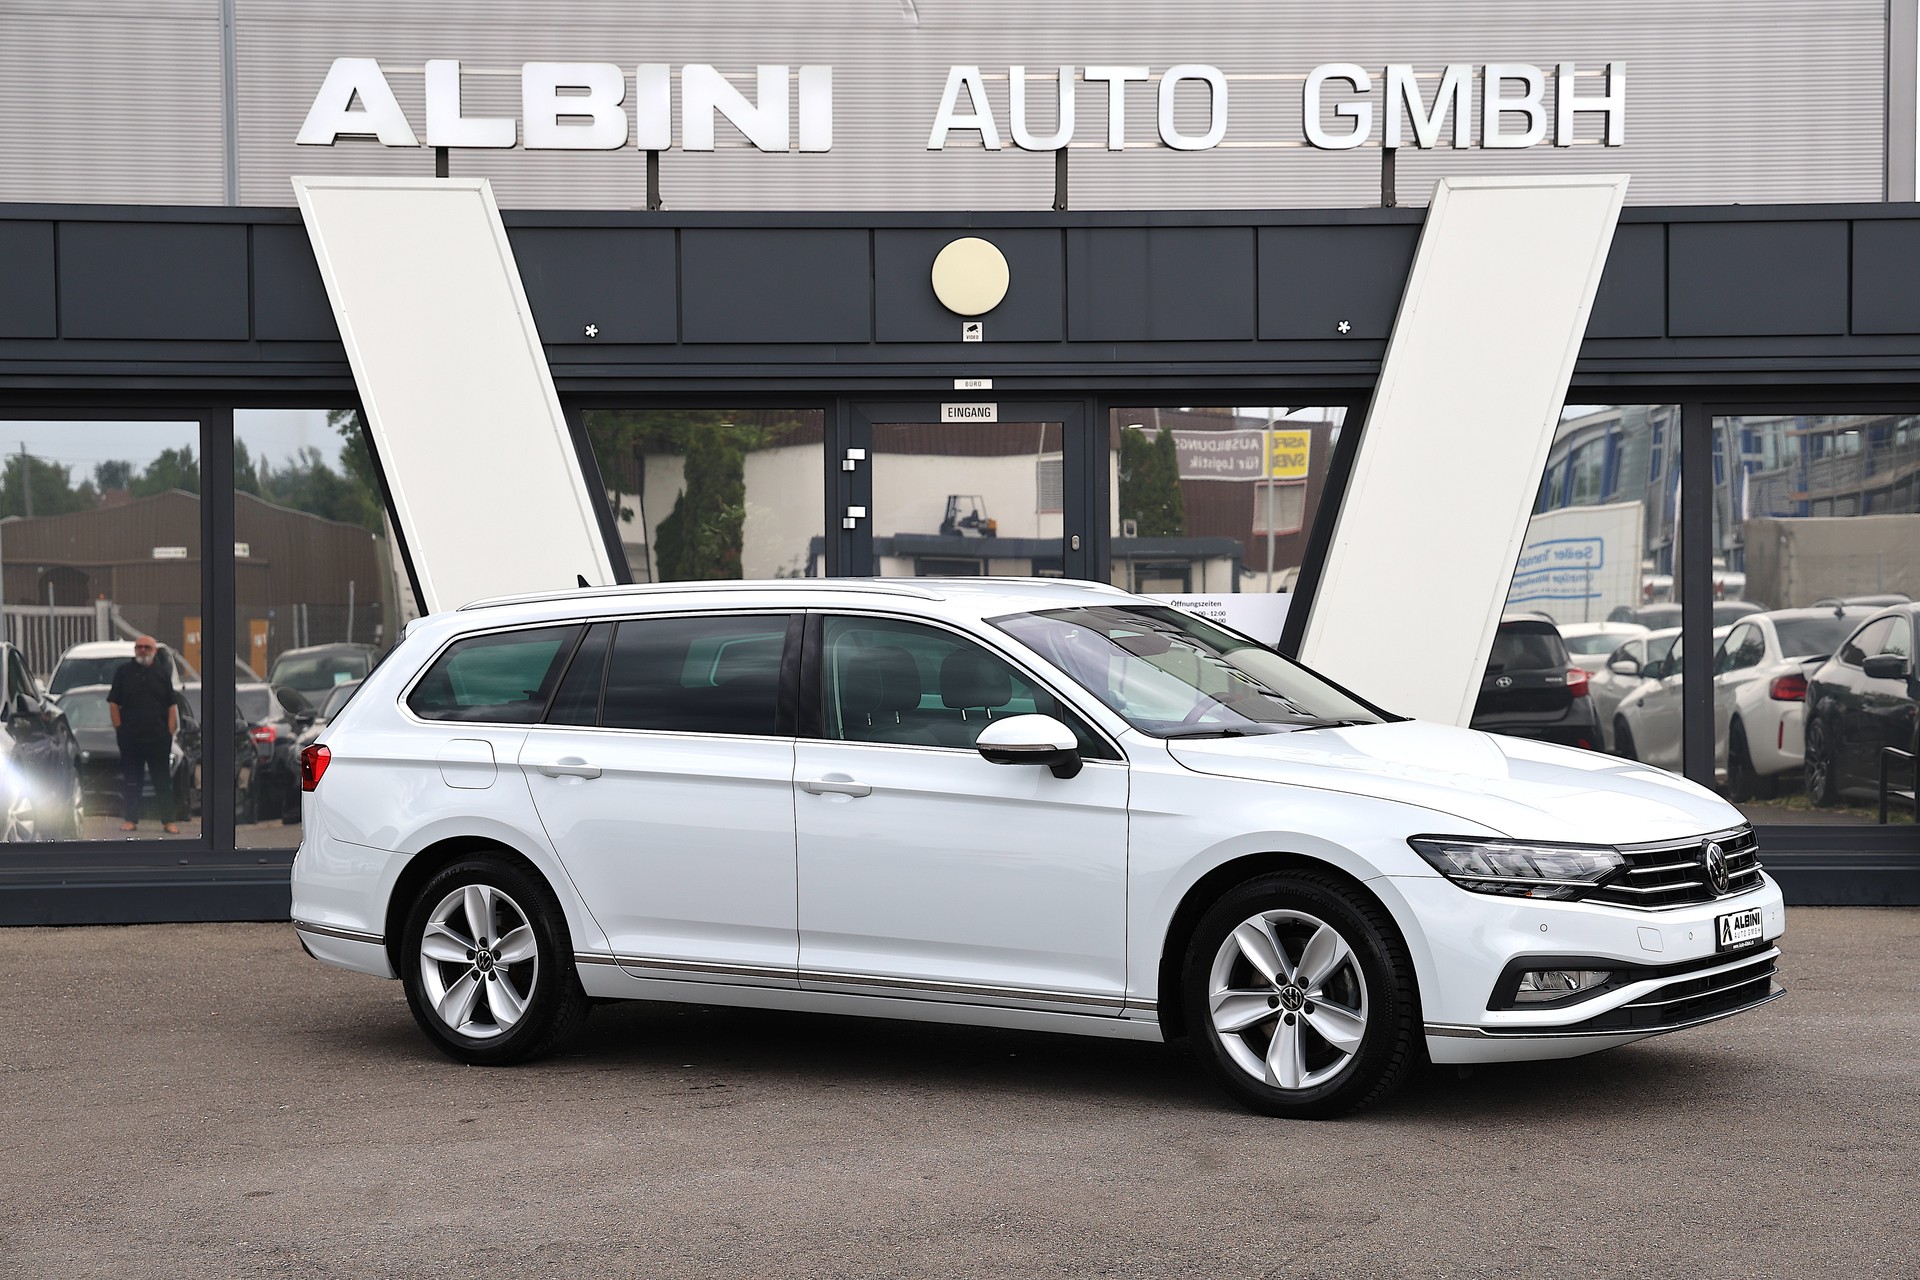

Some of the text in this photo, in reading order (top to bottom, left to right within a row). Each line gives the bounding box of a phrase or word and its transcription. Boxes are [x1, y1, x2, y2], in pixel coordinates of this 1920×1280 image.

[294, 57, 1627, 153] ALBINI AUTO GMBH
[947, 407, 991, 418] EINGANG
[1734, 912, 1760, 930] ALBINI
